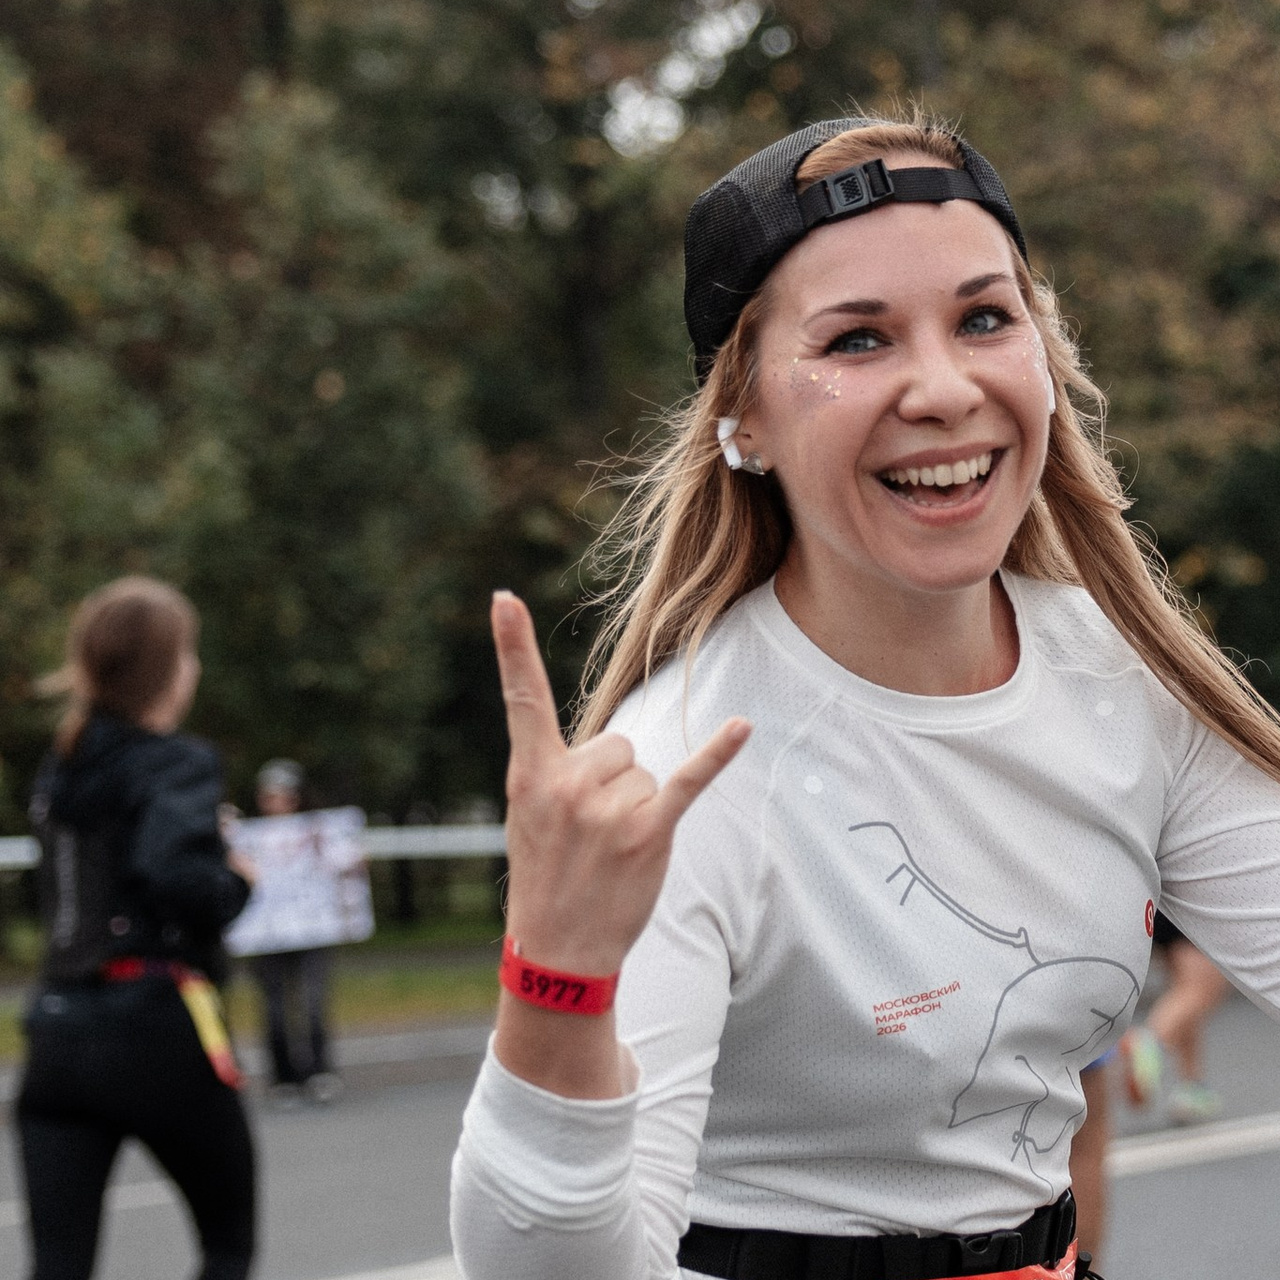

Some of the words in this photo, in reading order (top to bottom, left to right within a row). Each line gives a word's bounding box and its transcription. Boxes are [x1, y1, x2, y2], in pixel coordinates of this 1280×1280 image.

[520, 969, 587, 1006] 5977
[873, 980, 961, 1013] МОСКОВСКИЙ
[875, 1001, 942, 1025] МАРАФОН
[877, 1023, 907, 1036] 2026
